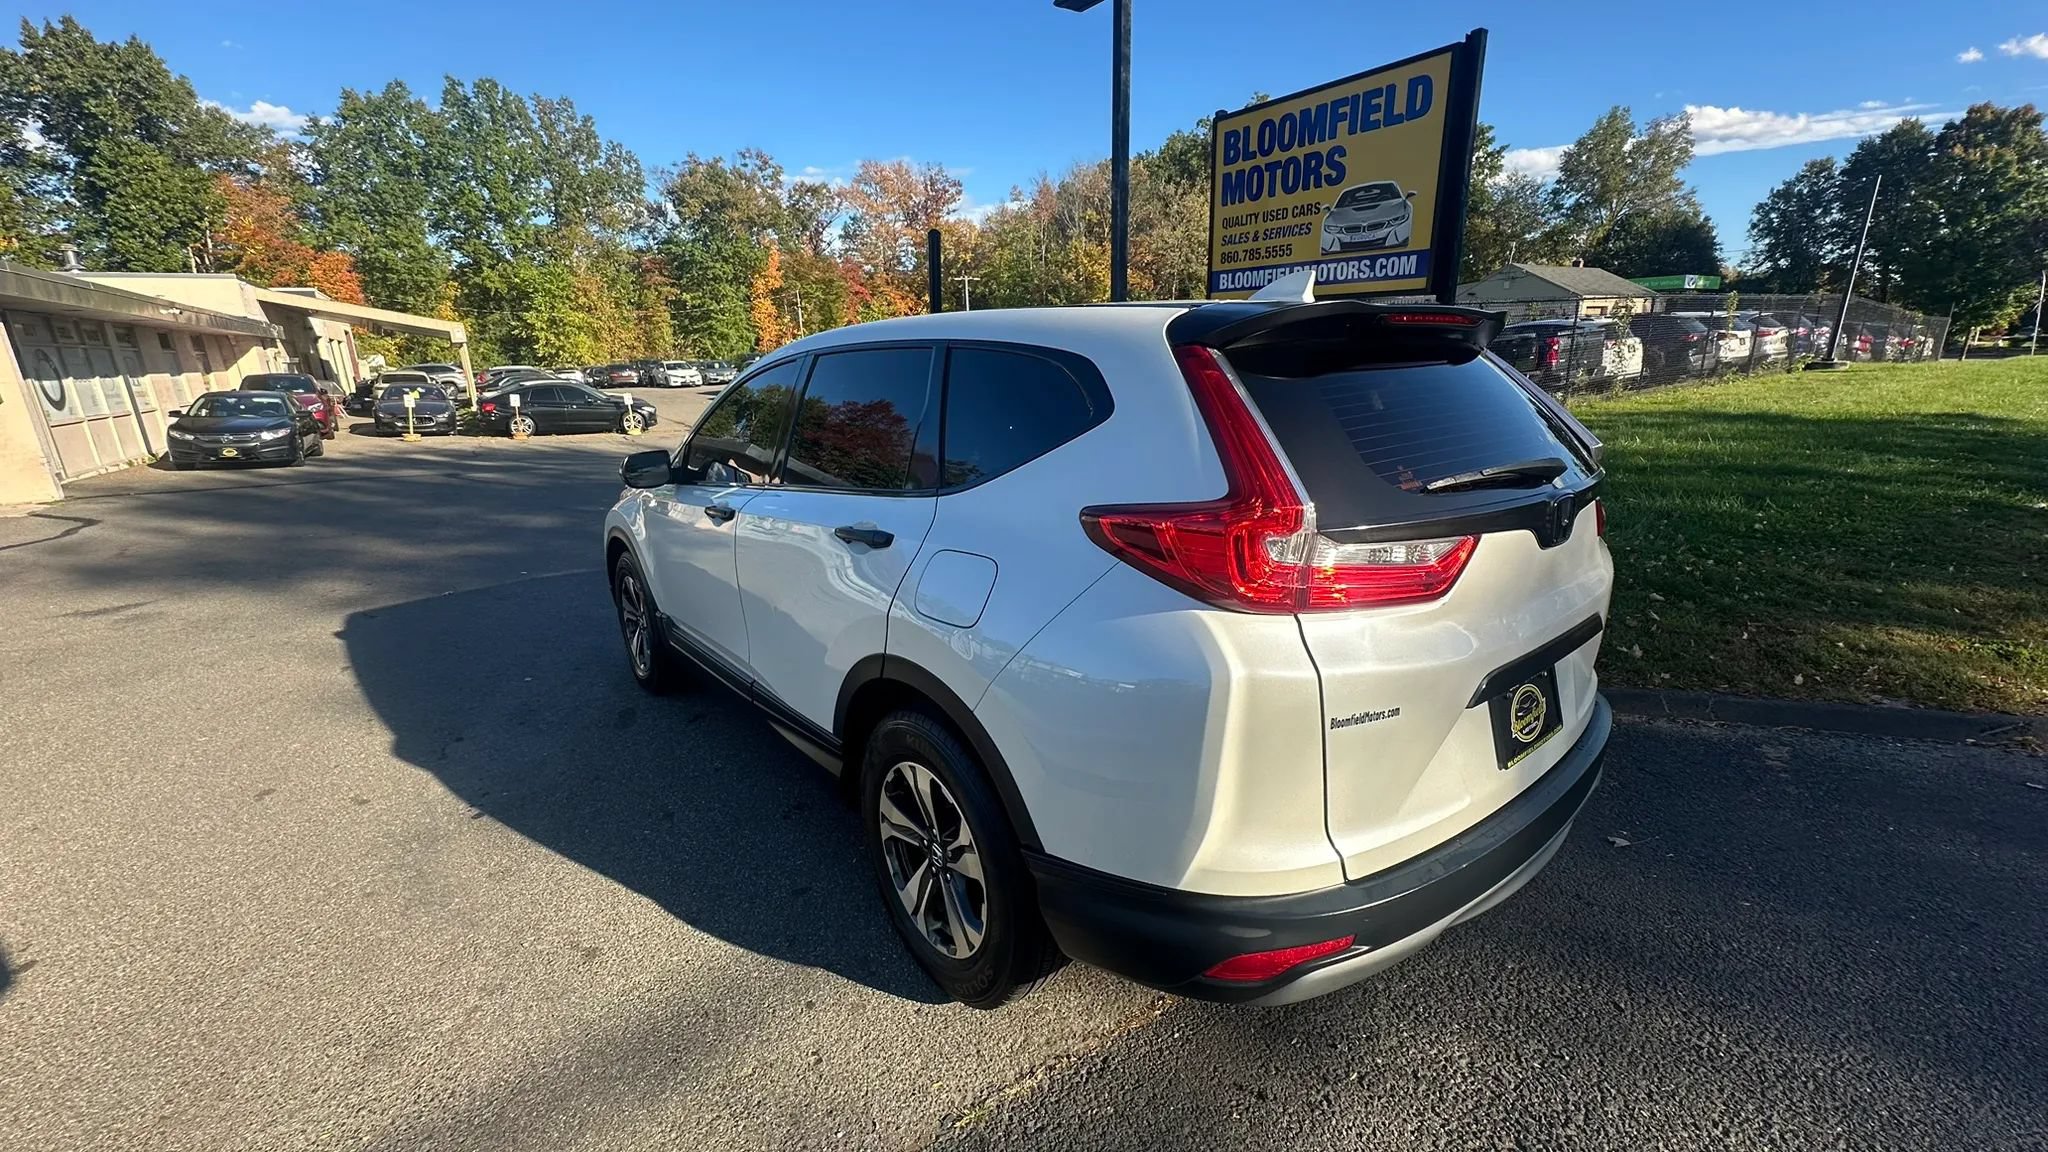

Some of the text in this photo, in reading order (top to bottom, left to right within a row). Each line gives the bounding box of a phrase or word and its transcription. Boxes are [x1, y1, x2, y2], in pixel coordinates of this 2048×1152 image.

[1223, 74, 1433, 167] BLOOMFIELD
[1221, 145, 1347, 207] MOTORS
[1222, 202, 1321, 229] QUALITY USED CARS
[1221, 222, 1313, 246] SALES & SERVICES
[1220, 243, 1293, 264] 860.785.5555
[1330, 706, 1400, 730] BloomfieldMotors.com
